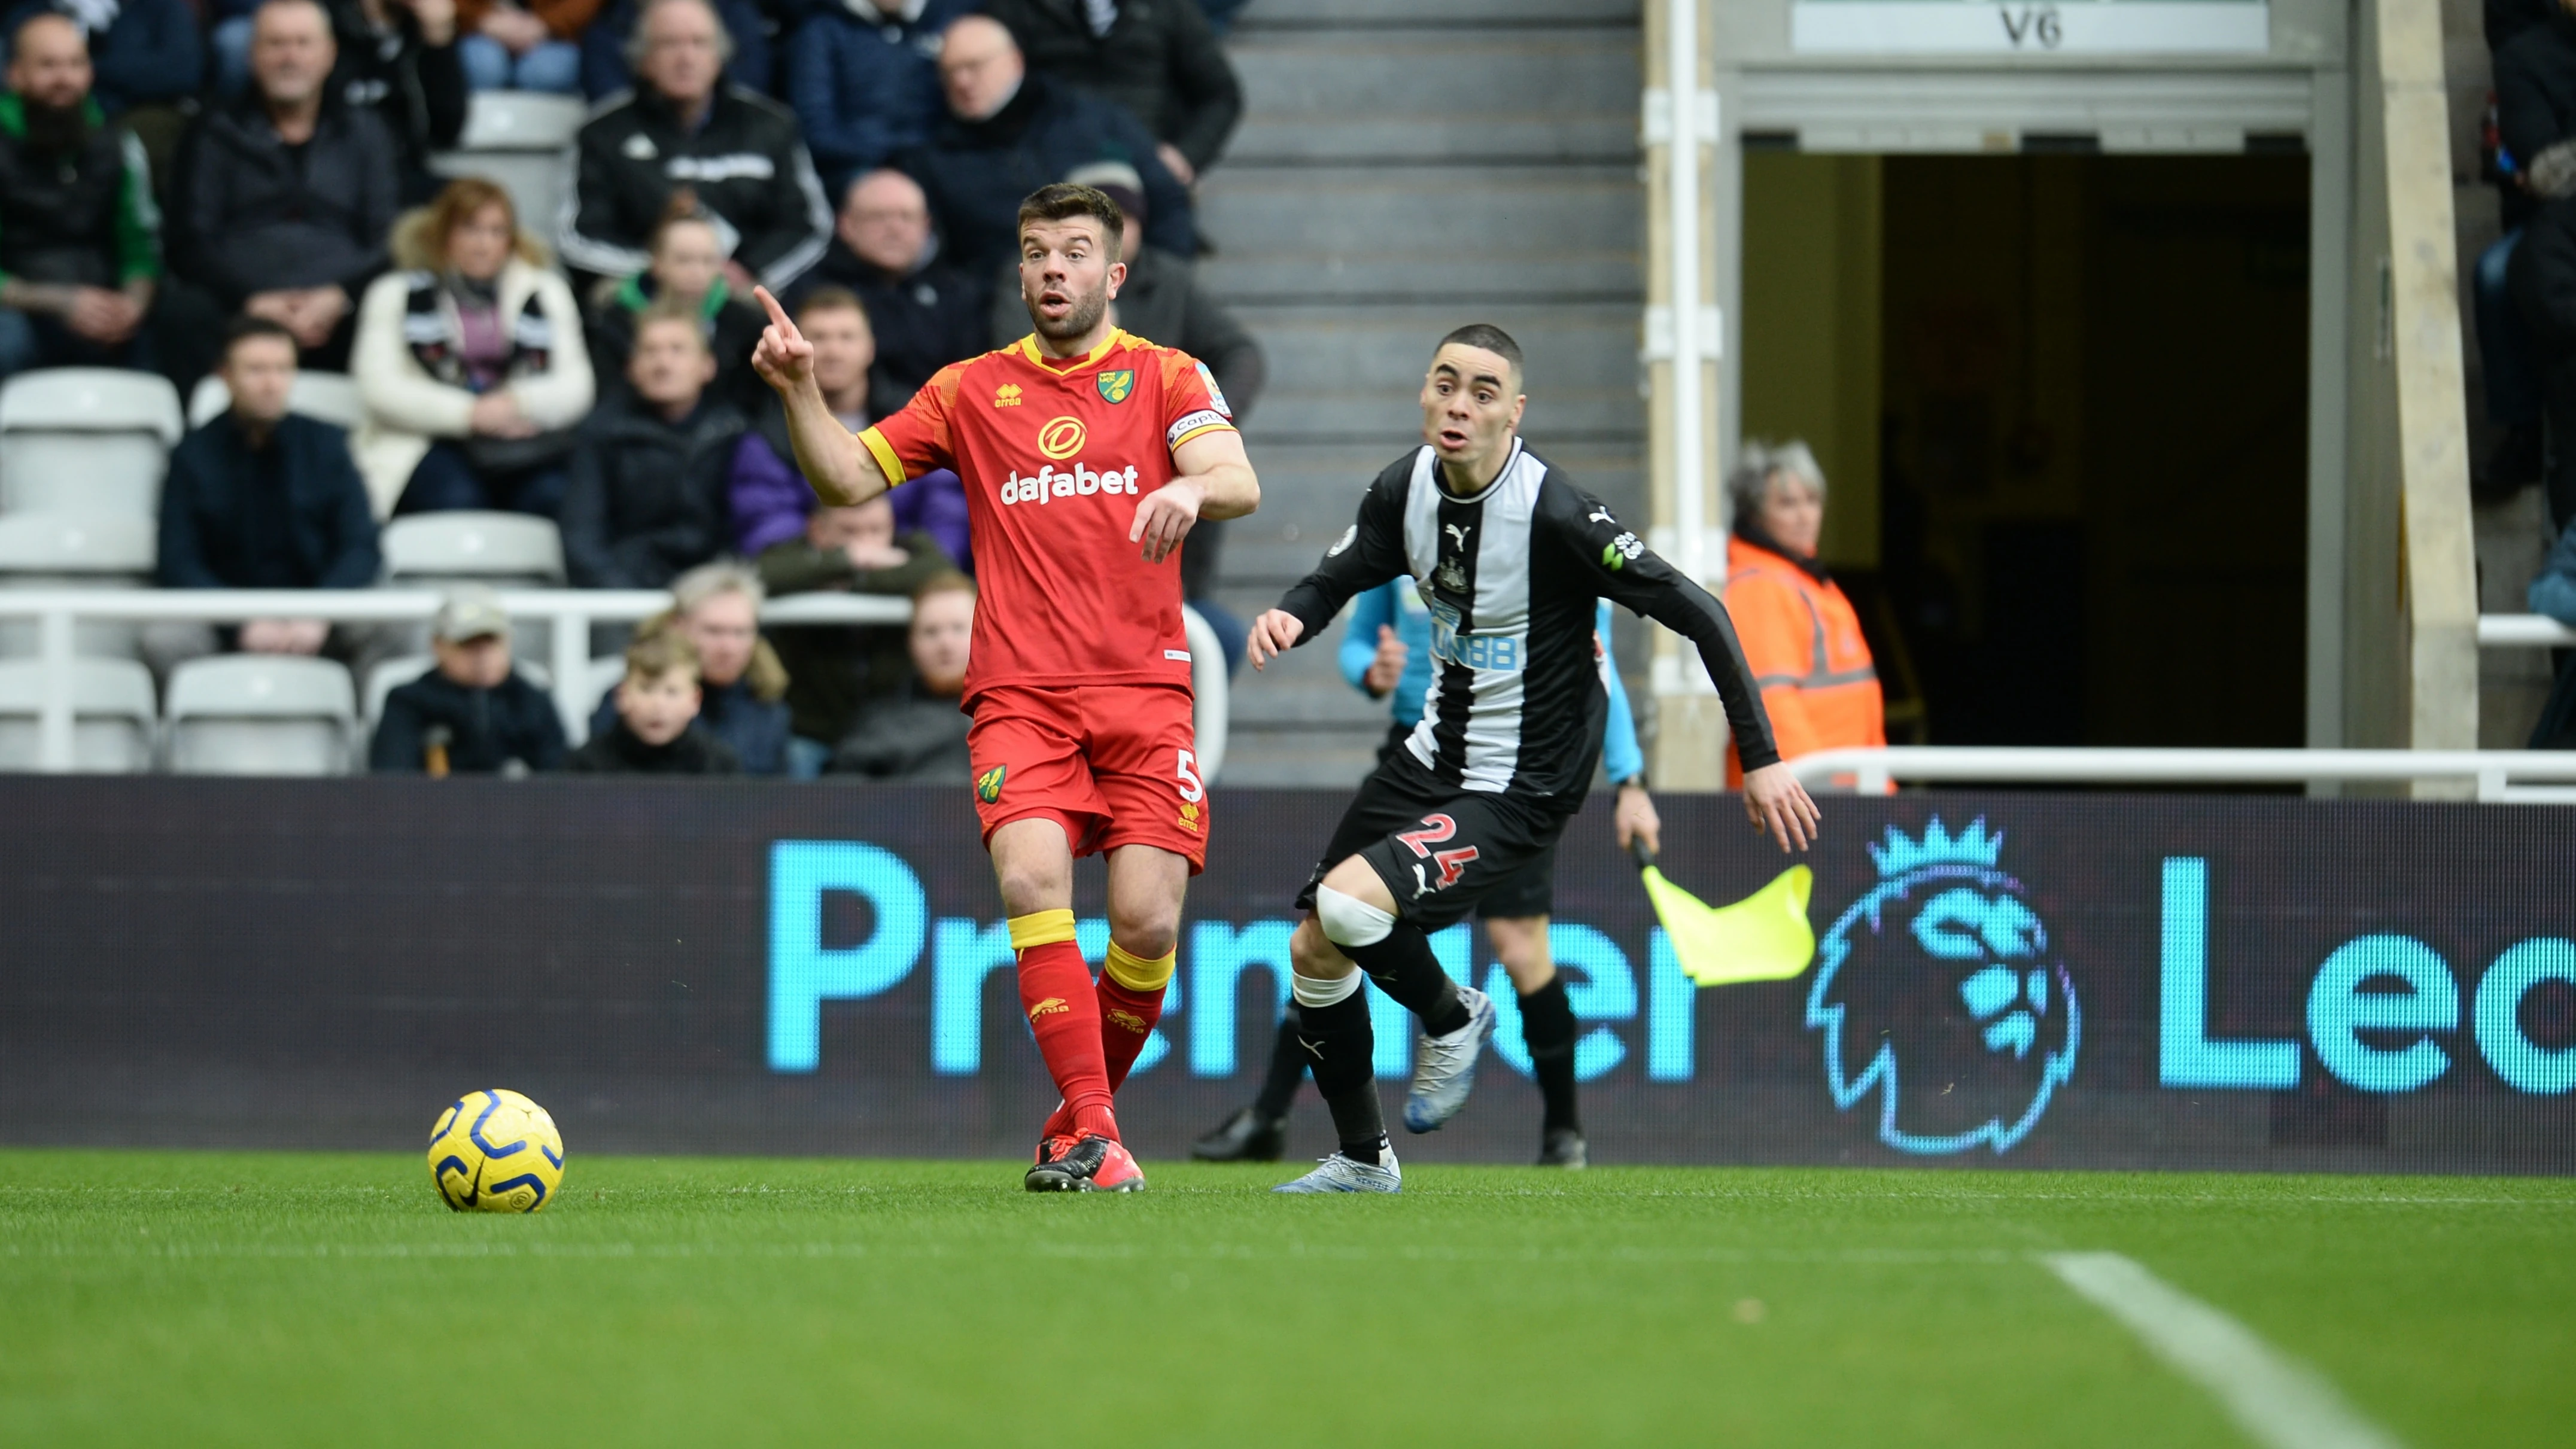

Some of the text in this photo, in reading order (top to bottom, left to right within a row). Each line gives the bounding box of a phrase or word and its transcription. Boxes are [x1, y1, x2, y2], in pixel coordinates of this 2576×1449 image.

[1999, 6, 2062, 48] V6
[1000, 462, 1139, 506] dafabet
[1178, 749, 1203, 803] 5
[1395, 813, 1480, 890] 24
